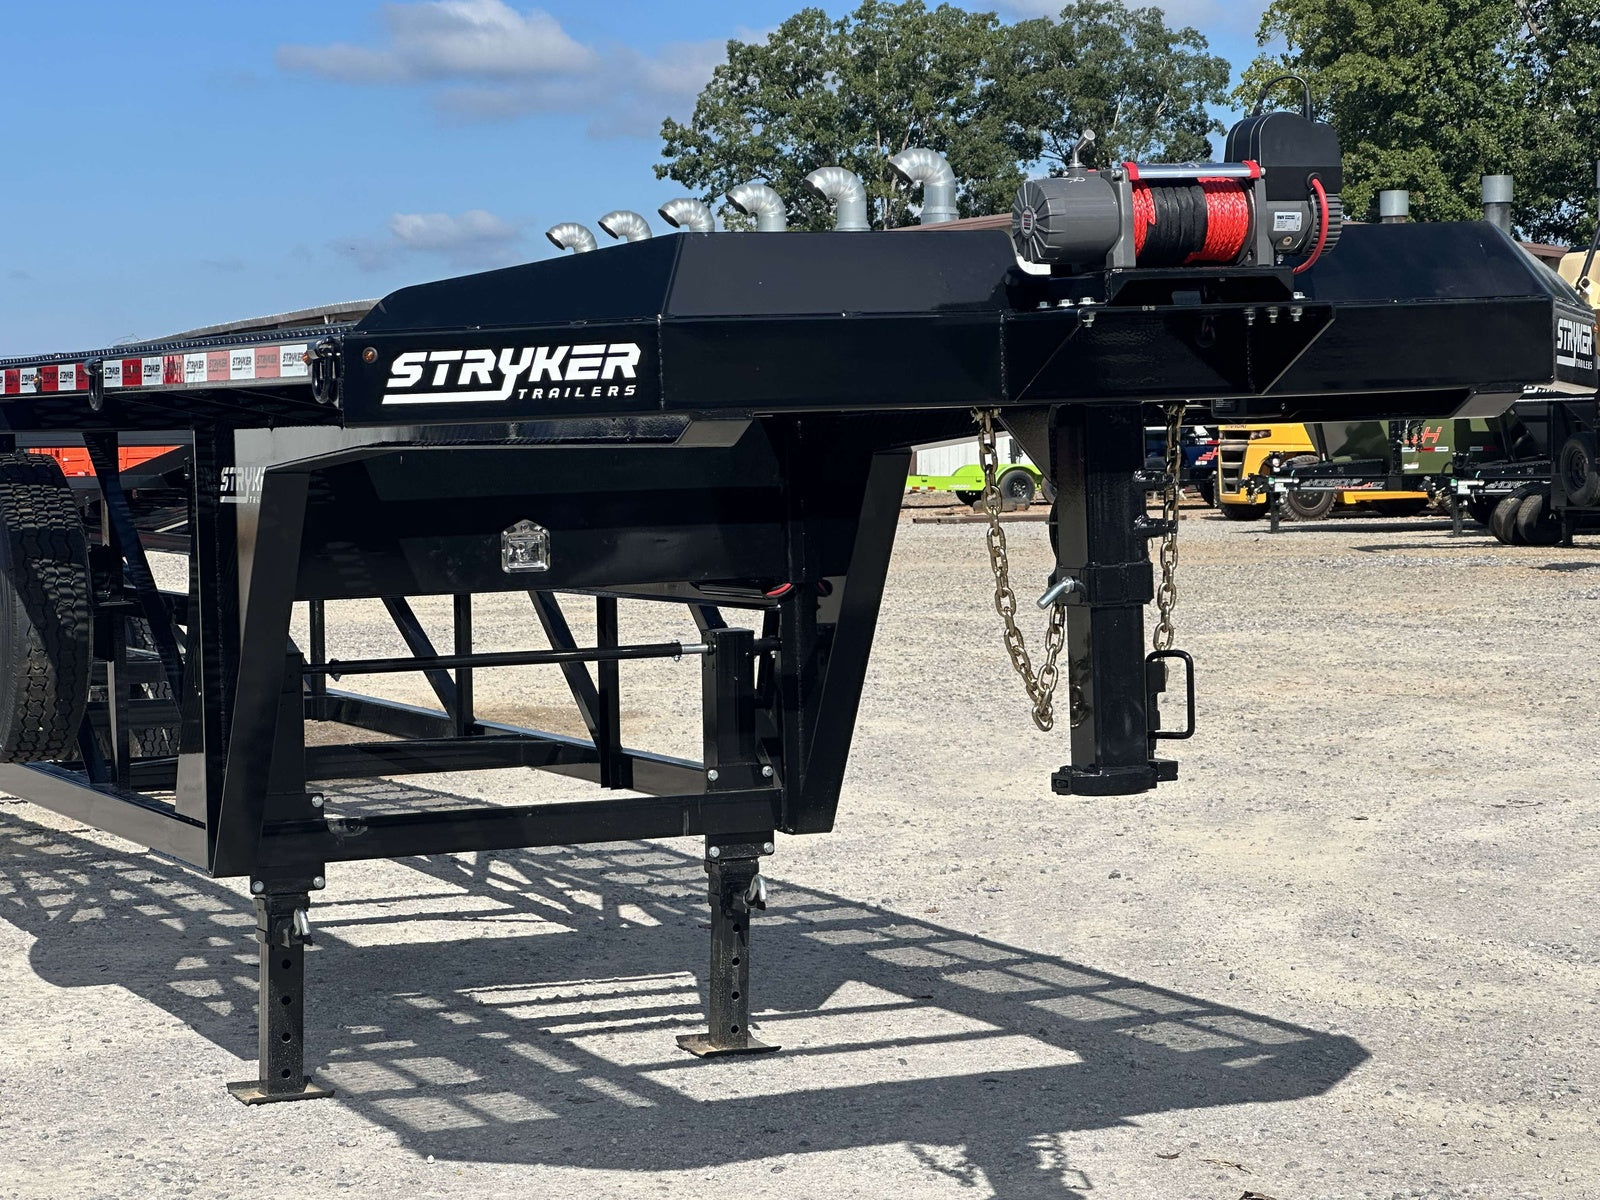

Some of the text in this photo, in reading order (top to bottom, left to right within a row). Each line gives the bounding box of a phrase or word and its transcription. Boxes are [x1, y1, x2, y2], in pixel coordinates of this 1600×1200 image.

[1556, 318, 1593, 367] STRYKER
[232, 356, 252, 370] STRYKER
[282, 352, 303, 367] STRYKE
[381, 342, 642, 405] STRYKER
[518, 384, 637, 400] TRAILERS
